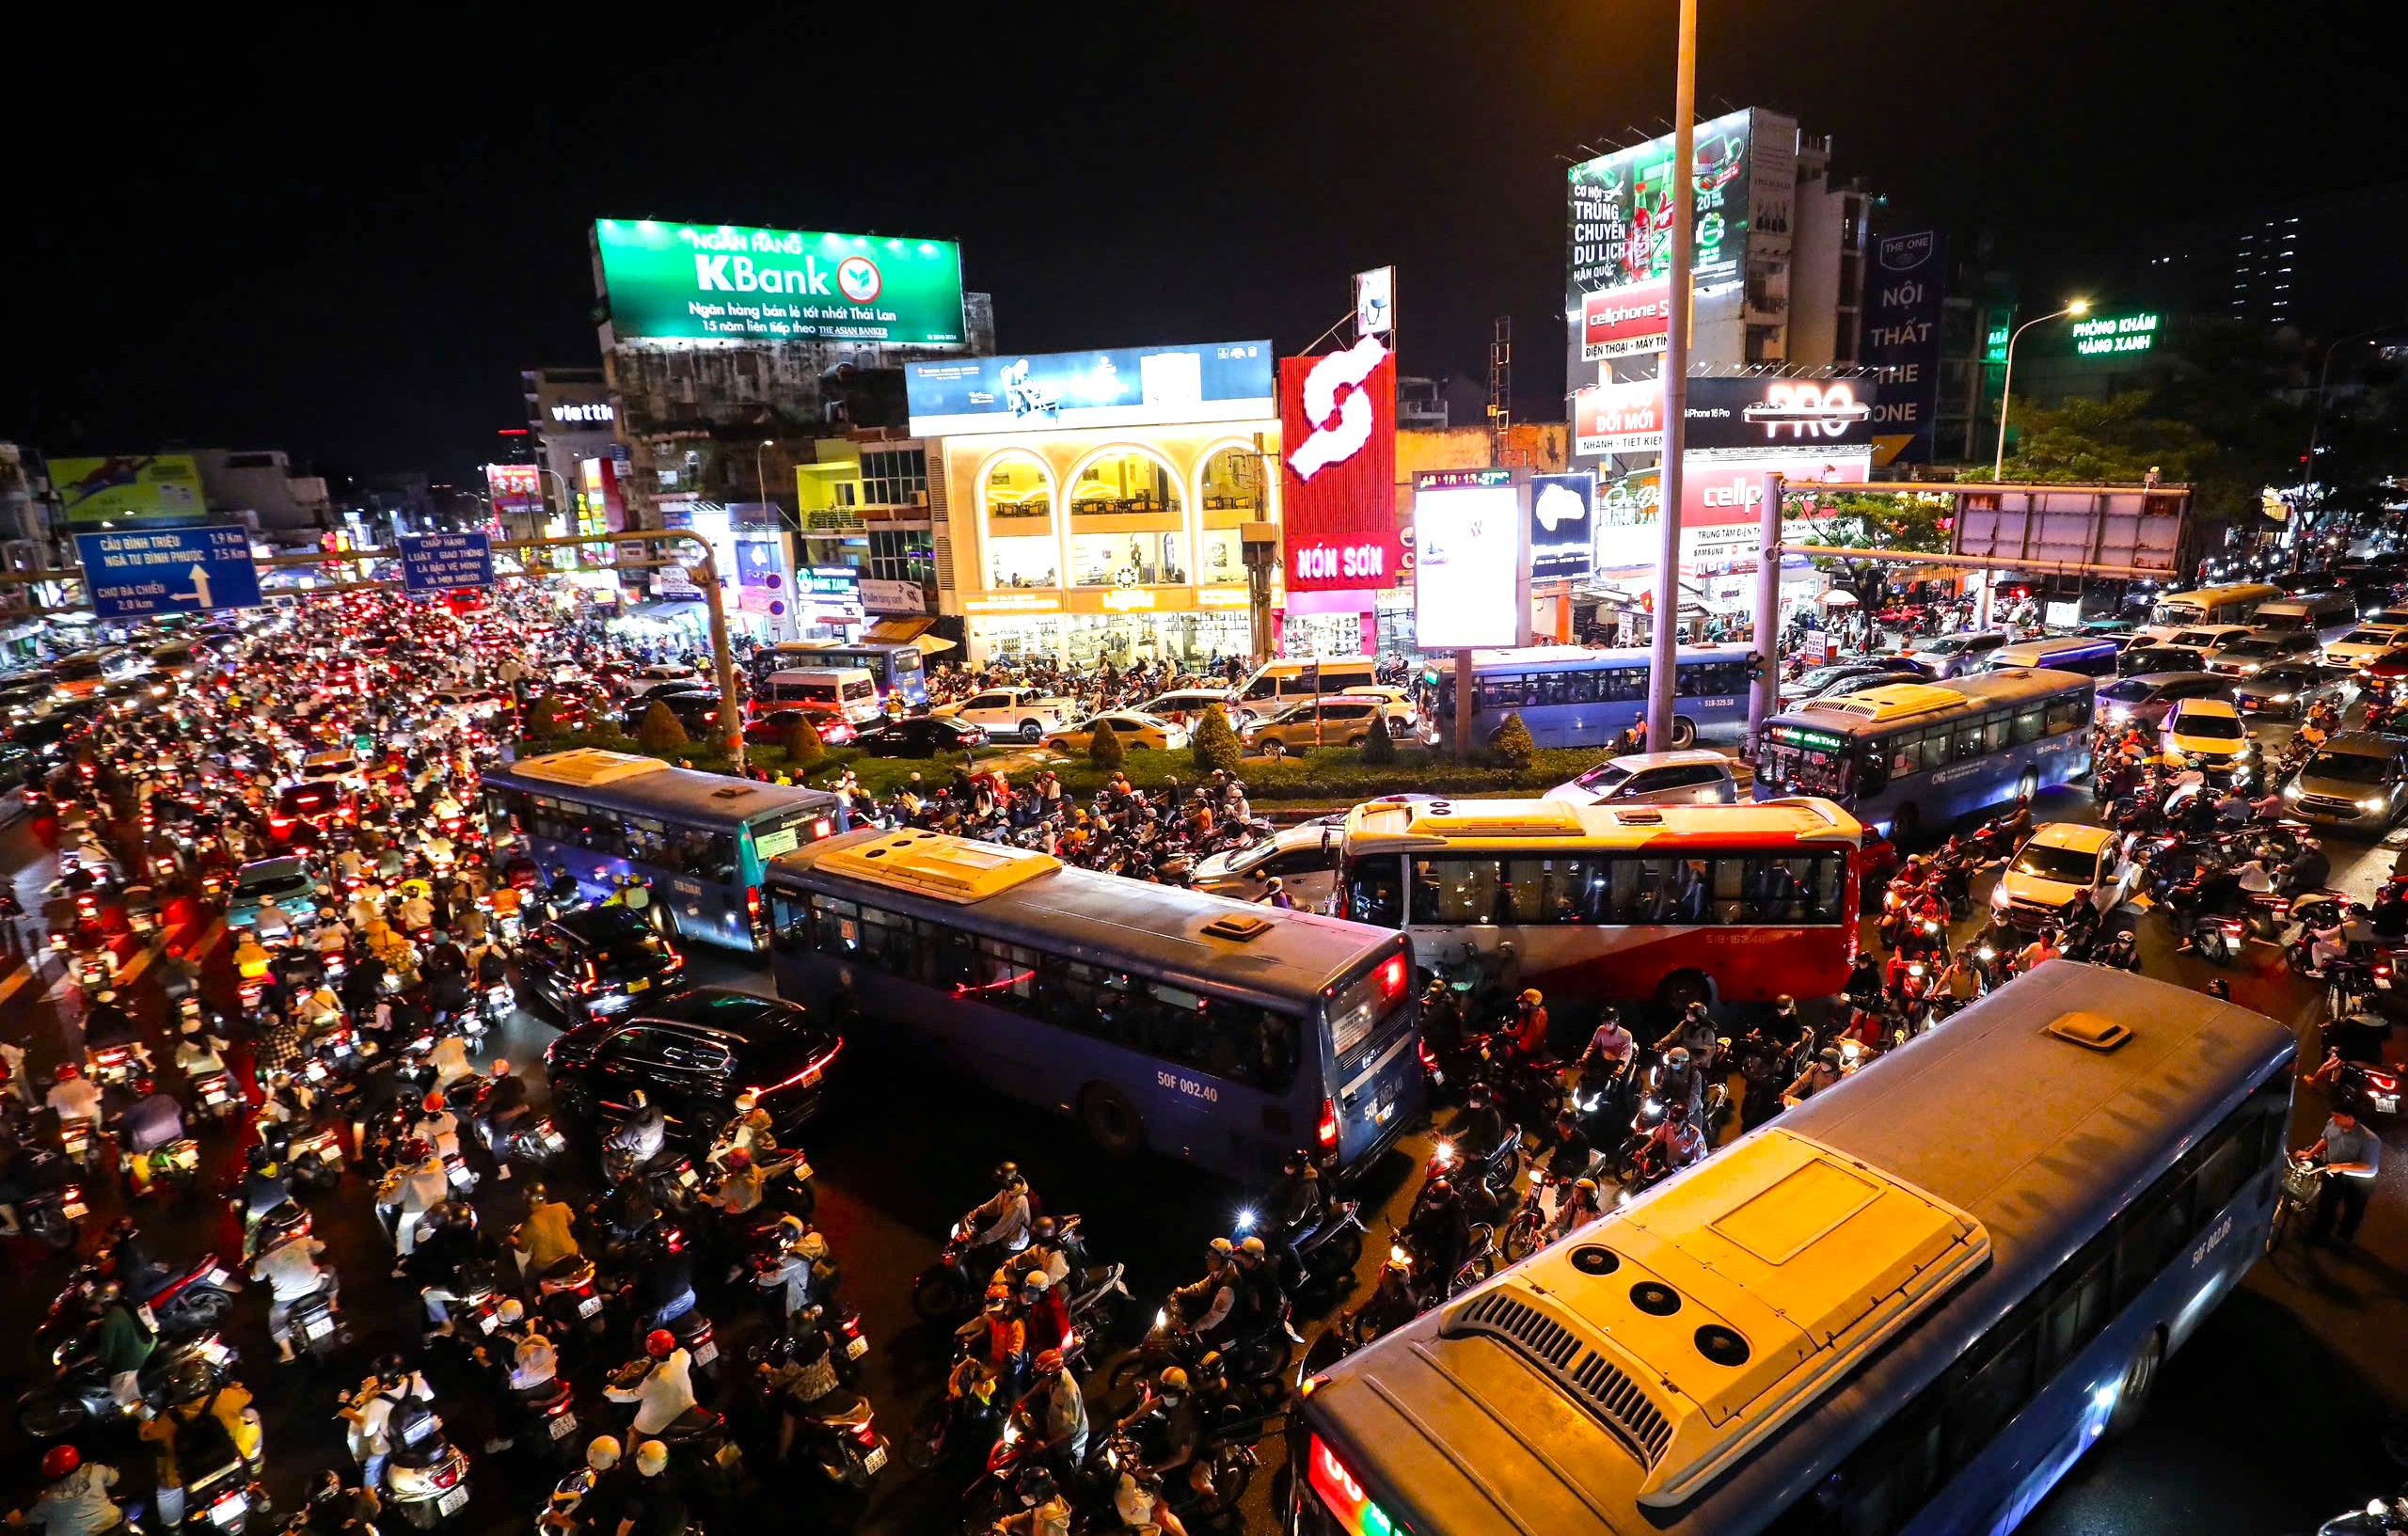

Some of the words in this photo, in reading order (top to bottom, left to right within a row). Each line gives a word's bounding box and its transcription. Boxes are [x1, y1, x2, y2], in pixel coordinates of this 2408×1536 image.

[1574, 184, 1588, 198] CƠ
[1588, 185, 1603, 201] HỘI
[1696, 194, 1711, 212] 20
[1574, 198, 1620, 220] TRÚNG
[1574, 219, 1626, 243] CHUYẾN
[1574, 245, 1595, 265] DU
[1598, 241, 1626, 263] LỊCH
[1884, 240, 1905, 253] THE
[1907, 237, 1929, 250] ONE
[693, 253, 832, 296] KBank
[1573, 266, 1592, 282] HÀN
[1881, 280, 1924, 311] NỘI
[688, 301, 726, 319] Ngân
[726, 301, 761, 321] hàng
[802, 305, 819, 319] tốt
[821, 306, 848, 320] nhất
[848, 306, 875, 321] Thái
[876, 308, 897, 322] Lan
[1589, 303, 1656, 327] cellphone
[702, 320, 718, 332] 15
[719, 321, 745, 332] năm
[746, 318, 768, 333] liên
[792, 320, 816, 334] theo
[818, 325, 833, 334] THE
[833, 326, 858, 335] ASIAN
[858, 326, 888, 337] BANKER
[1870, 317, 1933, 347] THẤT
[2072, 317, 2117, 339] PHÒNG
[2118, 311, 2157, 333] KHÁM
[1585, 344, 1604, 358] ĐIỆN
[1605, 341, 1628, 356] THOẠI
[1635, 336, 1654, 351] MÁY
[1656, 334, 1668, 348] TÍN
[2077, 336, 2114, 355] HÀNG
[2114, 334, 2151, 353] XANH
[1877, 363, 1920, 385] THE
[1624, 409, 1654, 431] MỚI
[1687, 408, 1711, 419] iPhone
[1711, 408, 1719, 418] 16
[1719, 408, 1731, 418] Pro
[1874, 403, 1918, 423] ONE
[1583, 437, 1613, 450] NHANH
[1703, 476, 1763, 515] cellp
[100, 534, 121, 552] CẦU
[123, 533, 150, 550] BÌNH
[150, 532, 182, 549] TRIỆU
[209, 532, 225, 546] 1.9
[1698, 530, 1720, 539] TRUNG
[1721, 528, 1735, 538] TÂM
[1736, 528, 1751, 538] ĐIỆN
[144, 550, 170, 564] BÌNH
[170, 547, 206, 563] PHƯỚC
[213, 548, 230, 562] 7.5
[1297, 542, 1338, 578] NÓN
[1343, 543, 1383, 577] SƠN
[1694, 546, 1724, 557] SAMSUNG
[1931, 771, 1946, 784] CNG
[1157, 1070, 1178, 1088] 50F
[1180, 1078, 1219, 1103] 002.40
[1364, 1097, 1380, 1122] 50F
[1379, 1074, 1403, 1108] 002.40
